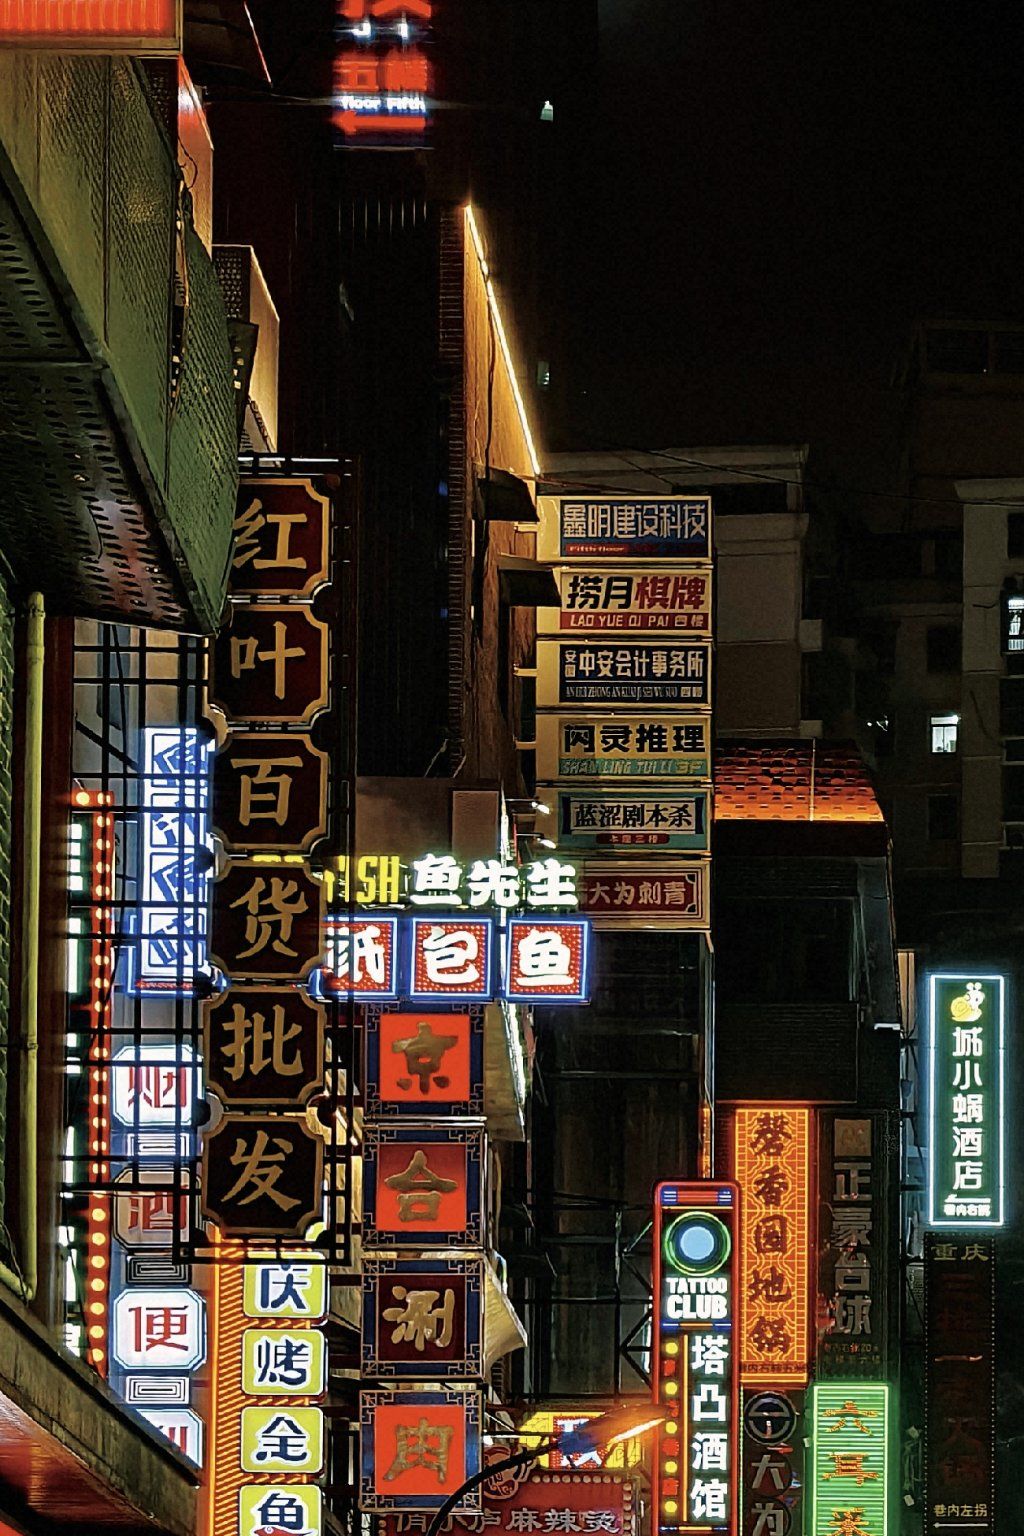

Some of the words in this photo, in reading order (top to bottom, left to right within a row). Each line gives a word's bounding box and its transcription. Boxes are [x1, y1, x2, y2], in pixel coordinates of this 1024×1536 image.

[563, 504, 706, 538] 鑫明建设科技
[566, 575, 706, 610] 捞月棋牌
[570, 614, 595, 627] LAO
[600, 614, 624, 627] YUE
[648, 614, 669, 627] PAI
[578, 649, 704, 678] 中安会计事务所
[564, 723, 706, 753] 闪灵推理
[574, 803, 693, 828] 蓝涩剧本杀
[221, 500, 308, 1210] 红叶百货批发
[410, 853, 579, 907] 鱼先生
[588, 881, 687, 905] 大为刺青
[326, 925, 576, 987] 纸包鱼
[383, 1020, 460, 1485] 京合涮肉
[931, 1244, 989, 1261] 重庆
[666, 1277, 728, 1293] TATTOO
[666, 1294, 728, 1319] CLUB
[690, 1334, 729, 1519] 塔凸酒馆
